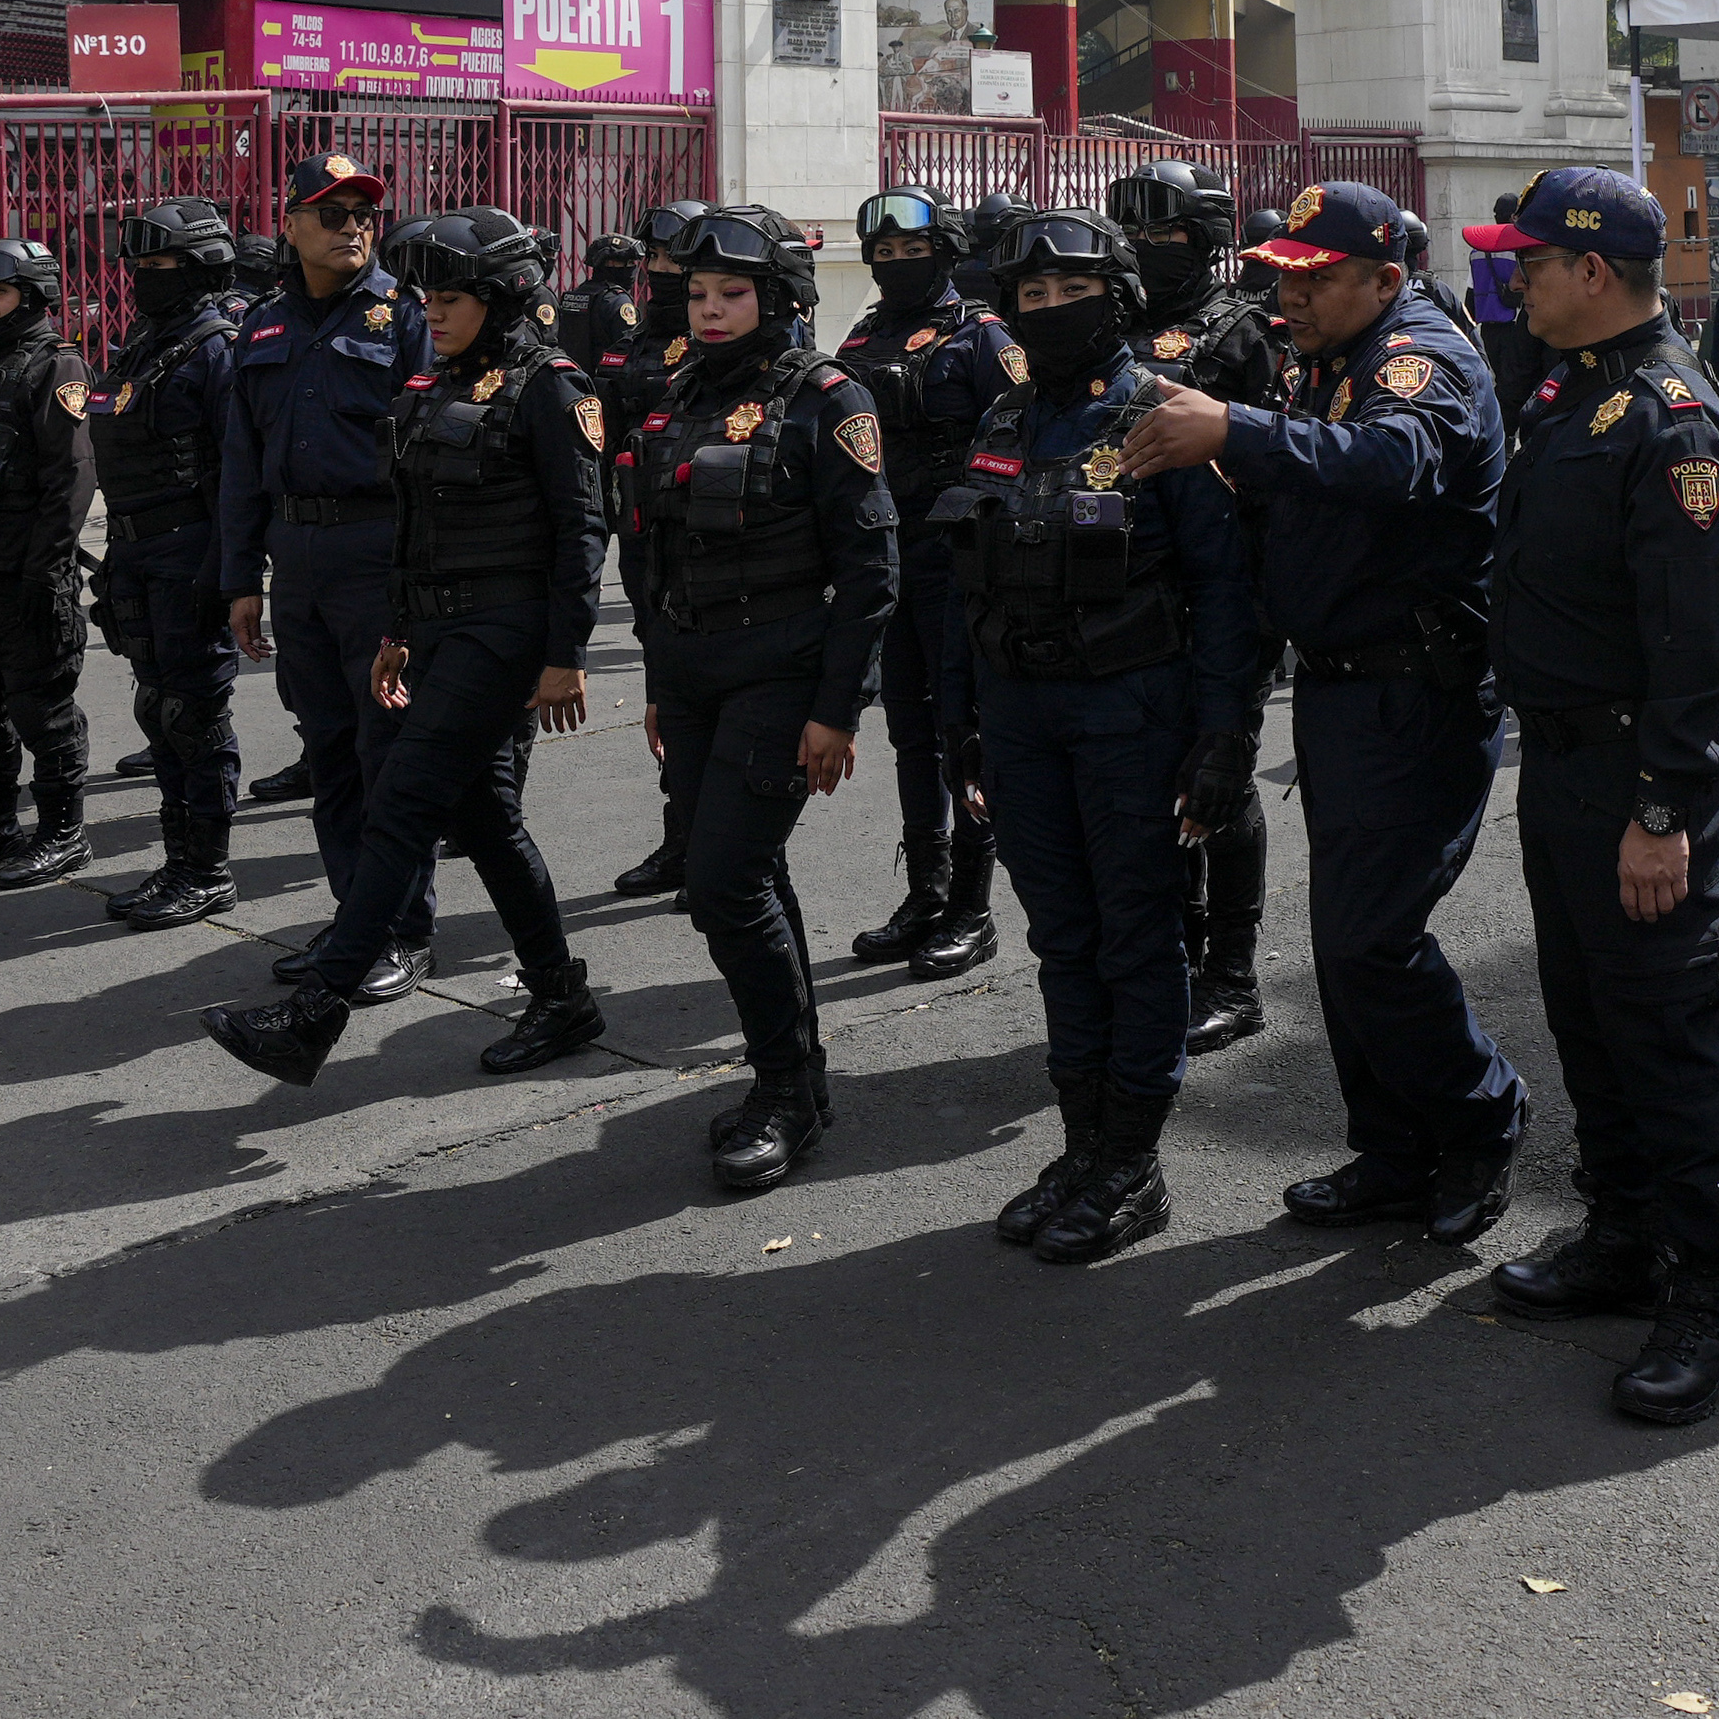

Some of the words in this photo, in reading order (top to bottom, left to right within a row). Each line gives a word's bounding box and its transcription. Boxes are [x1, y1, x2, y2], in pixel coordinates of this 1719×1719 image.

[292, 14, 323, 32] PALCOS
[292, 32, 322, 48] 74-54
[470, 27, 502, 49] ACCES
[339, 39, 429, 69] 11,10,9,8,7,6
[283, 55, 330, 73] LUMBRERAS
[1565, 208, 1602, 230] SSC
[1234, 284, 1270, 302] POLIC
[1379, 358, 1426, 374] POLICIA
[840, 417, 873, 438] POLICIA
[987, 460, 1007, 471] REYES
[1671, 461, 1718, 479] POLICIA
